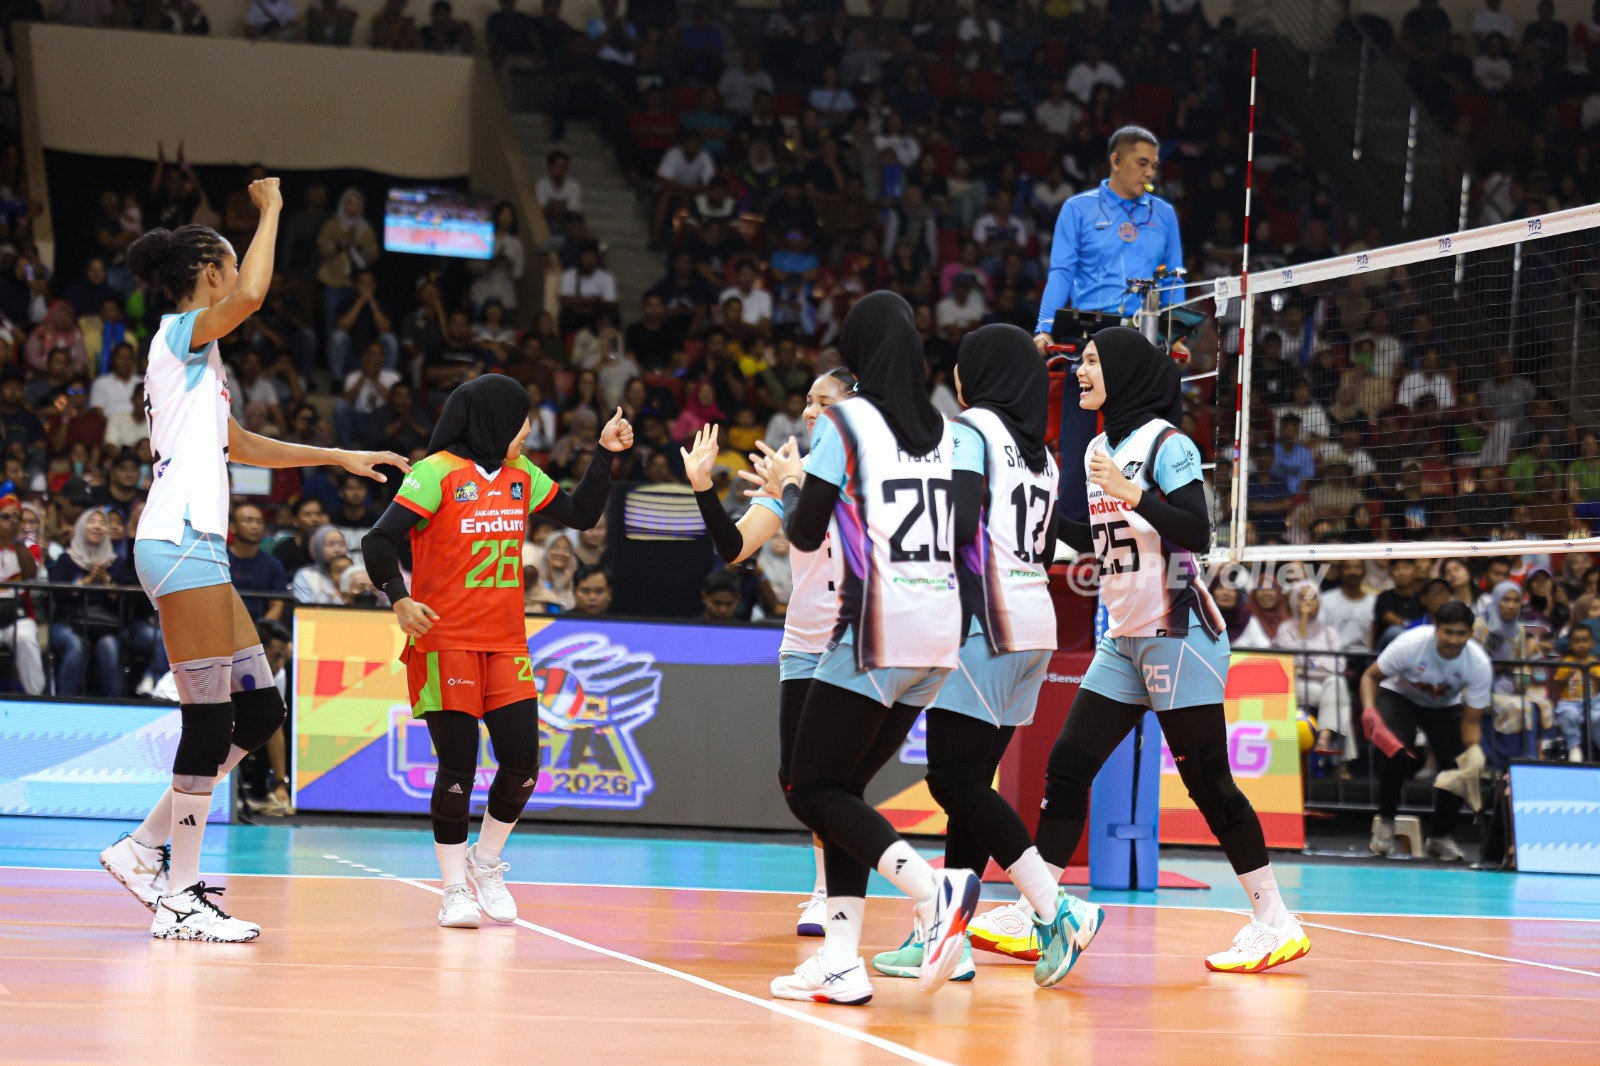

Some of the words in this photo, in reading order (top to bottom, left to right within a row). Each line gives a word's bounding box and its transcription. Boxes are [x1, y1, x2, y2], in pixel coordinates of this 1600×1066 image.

[474, 509, 499, 517] JAKARTA
[1088, 497, 1133, 515] nduro
[881, 478, 952, 563] 20
[1092, 519, 1141, 578] 25
[465, 539, 520, 589] 26
[513, 656, 535, 682] 2
[1048, 672, 1086, 684] Seno
[1143, 664, 1172, 693] 25
[554, 772, 630, 797] 2026
